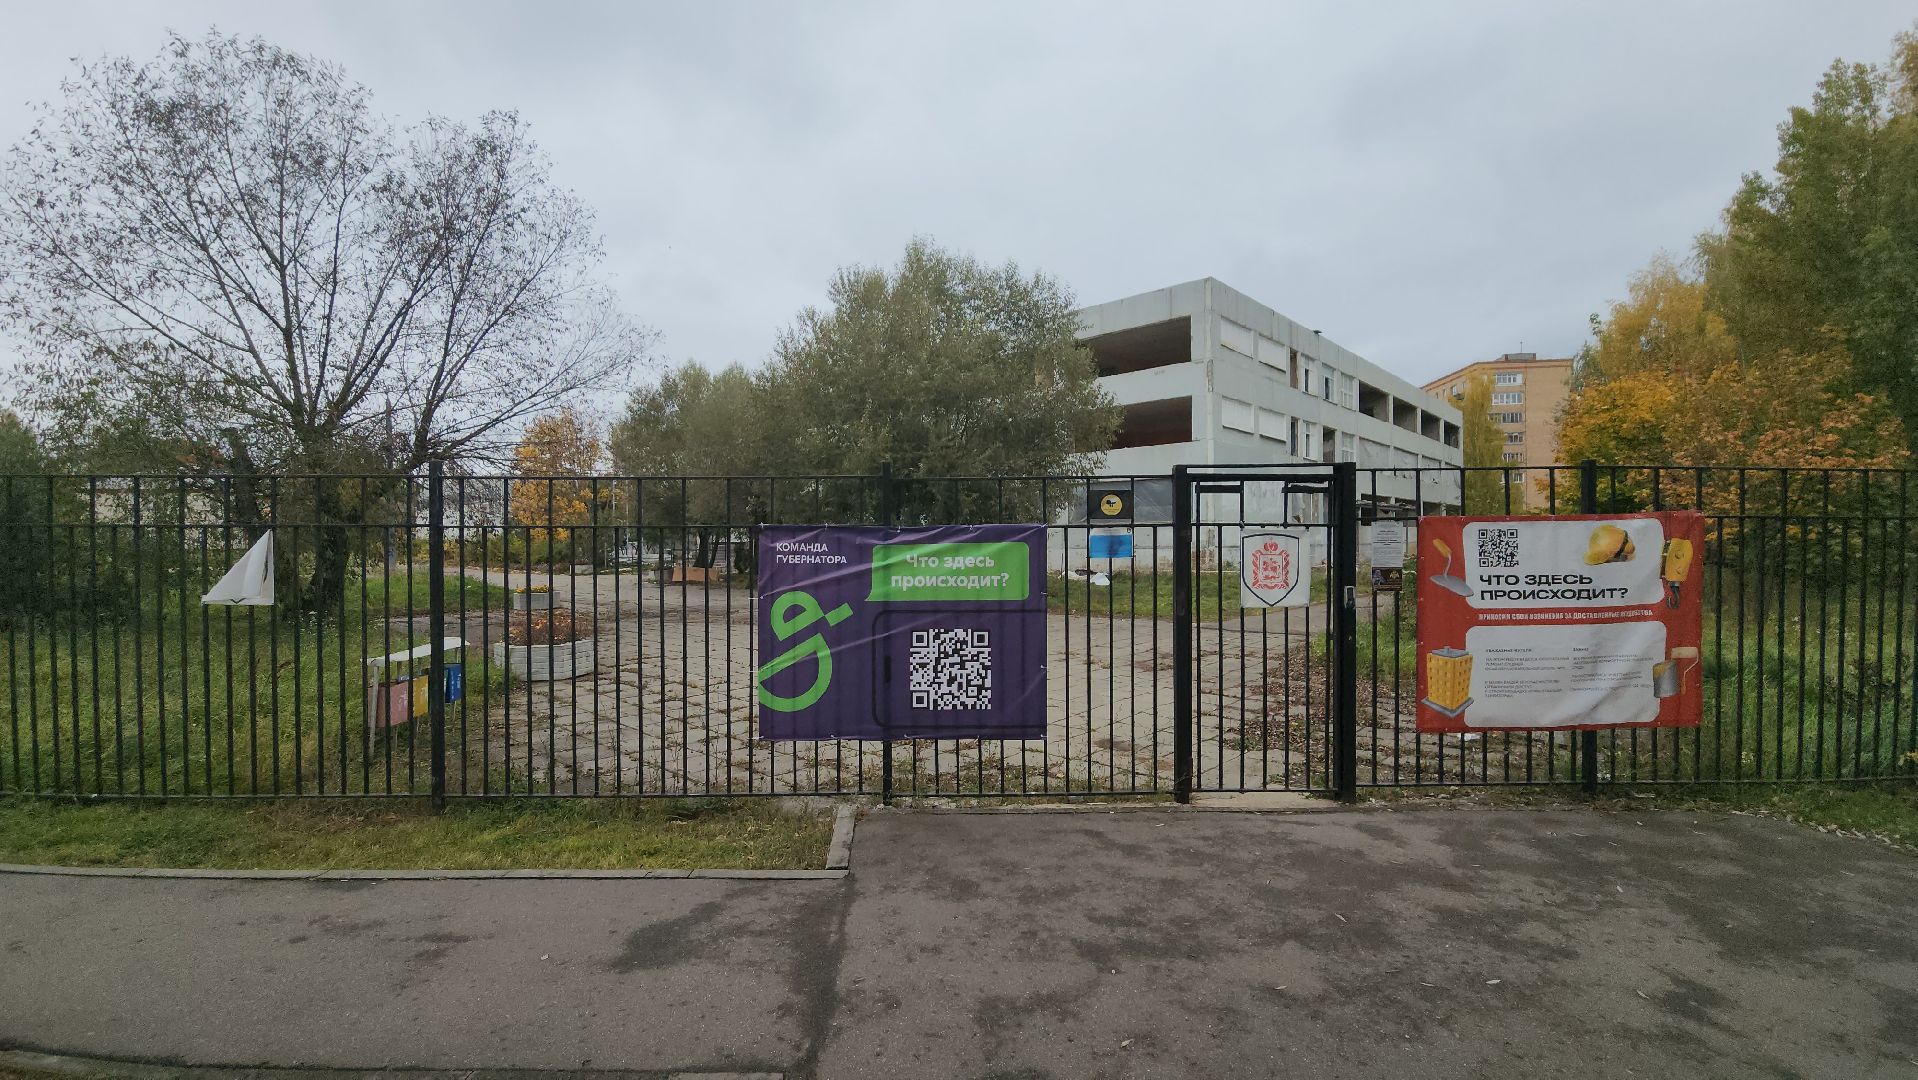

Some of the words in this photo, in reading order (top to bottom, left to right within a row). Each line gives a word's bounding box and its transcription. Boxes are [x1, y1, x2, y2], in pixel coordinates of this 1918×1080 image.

[776, 542, 828, 553] КОМАНДА
[776, 554, 847, 564] ГУБЕРНАТОРА
[906, 554, 939, 568] Что
[943, 556, 995, 570] здесь
[891, 572, 1009, 591] происходит?
[1479, 574, 1520, 586] ЧТО
[1524, 574, 1593, 586] ЗДЕСЬ
[1480, 587, 1628, 601] ПРОИСХОДИТ?
